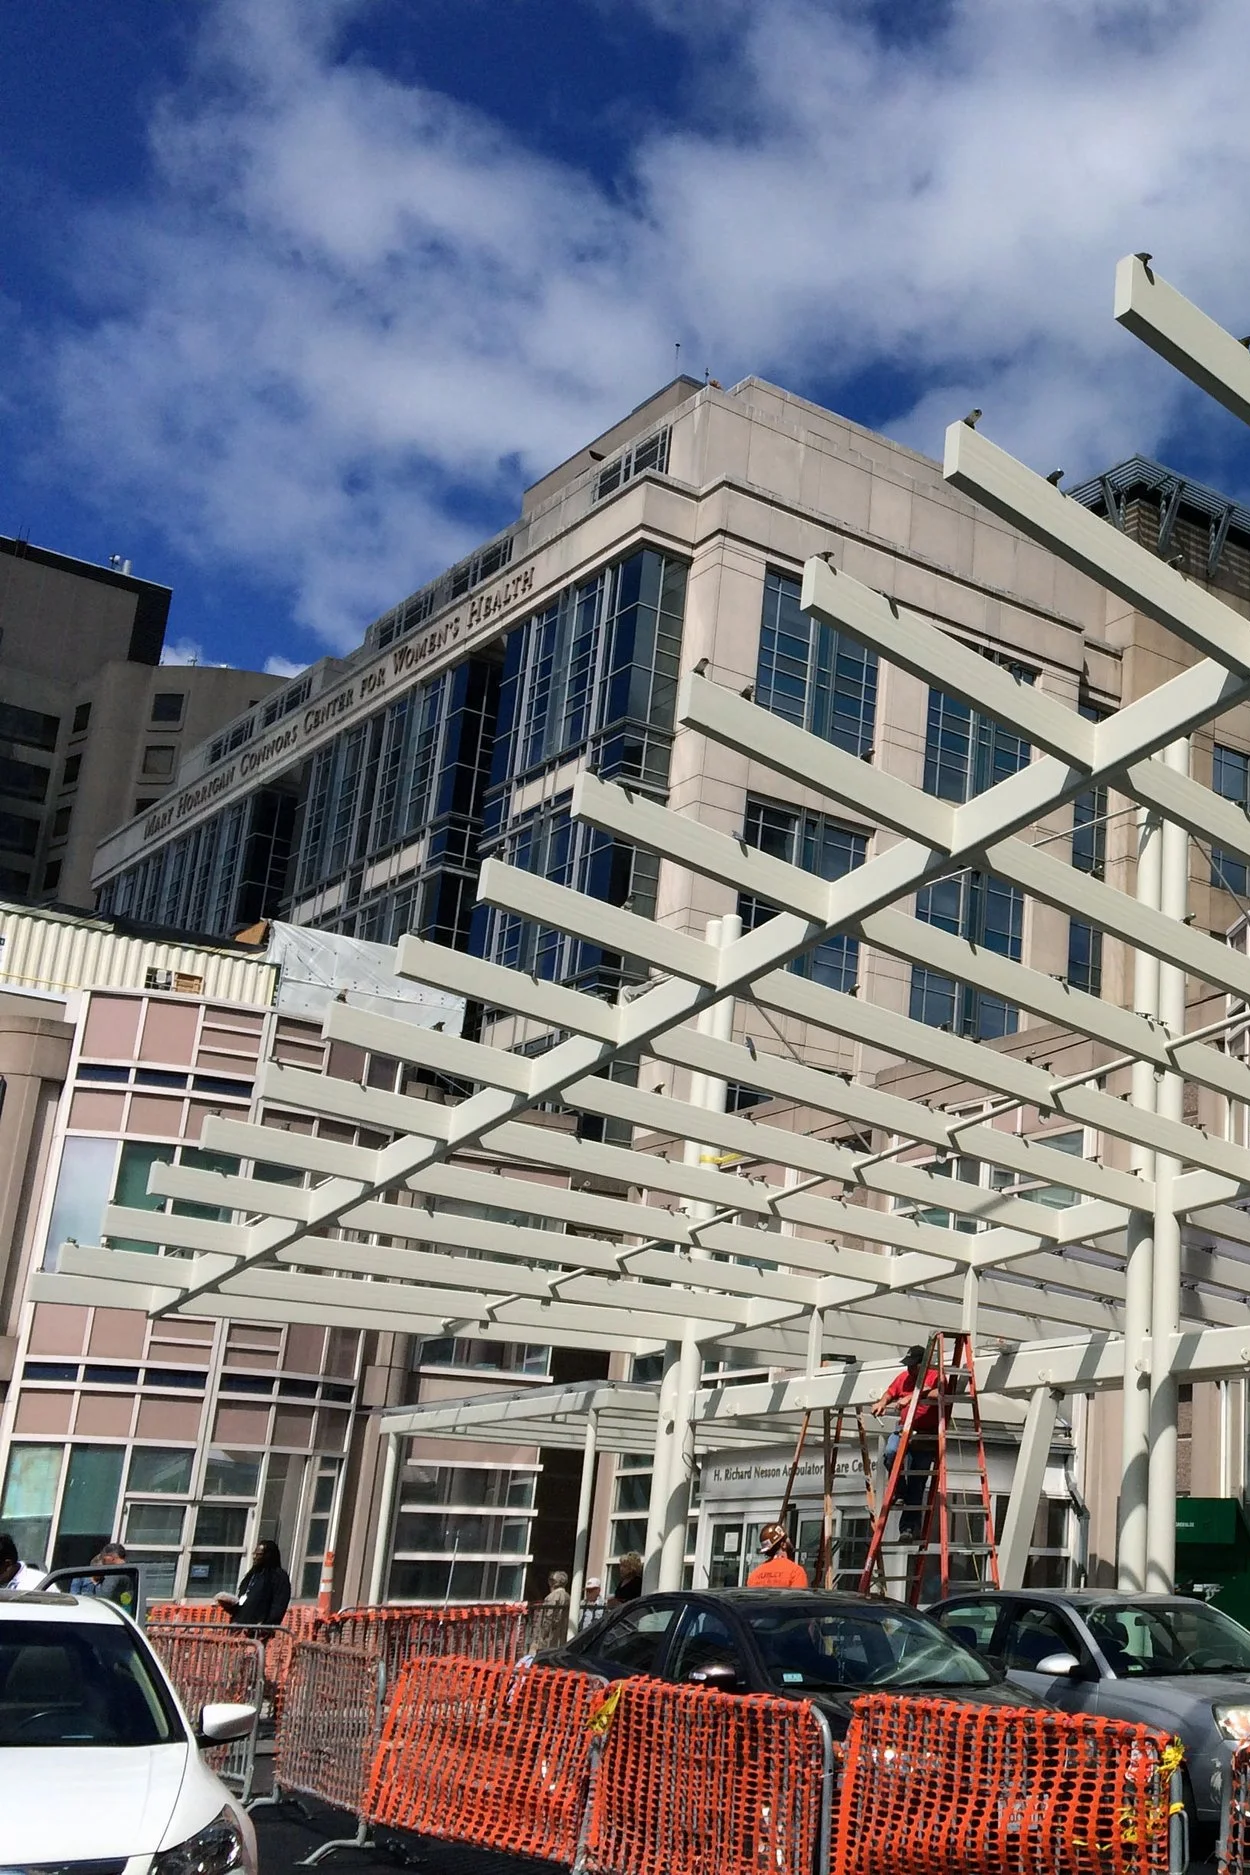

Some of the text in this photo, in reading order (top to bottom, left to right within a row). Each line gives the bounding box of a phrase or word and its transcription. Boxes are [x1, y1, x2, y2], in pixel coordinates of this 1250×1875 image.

[143, 566, 535, 840] MARY HORRIGAN CONNORS CENTER FOR WOMEN'S HEALTH
[713, 1469, 722, 1482] H.
[724, 1466, 752, 1481] Richard
[754, 1466, 781, 1479] Nesson
